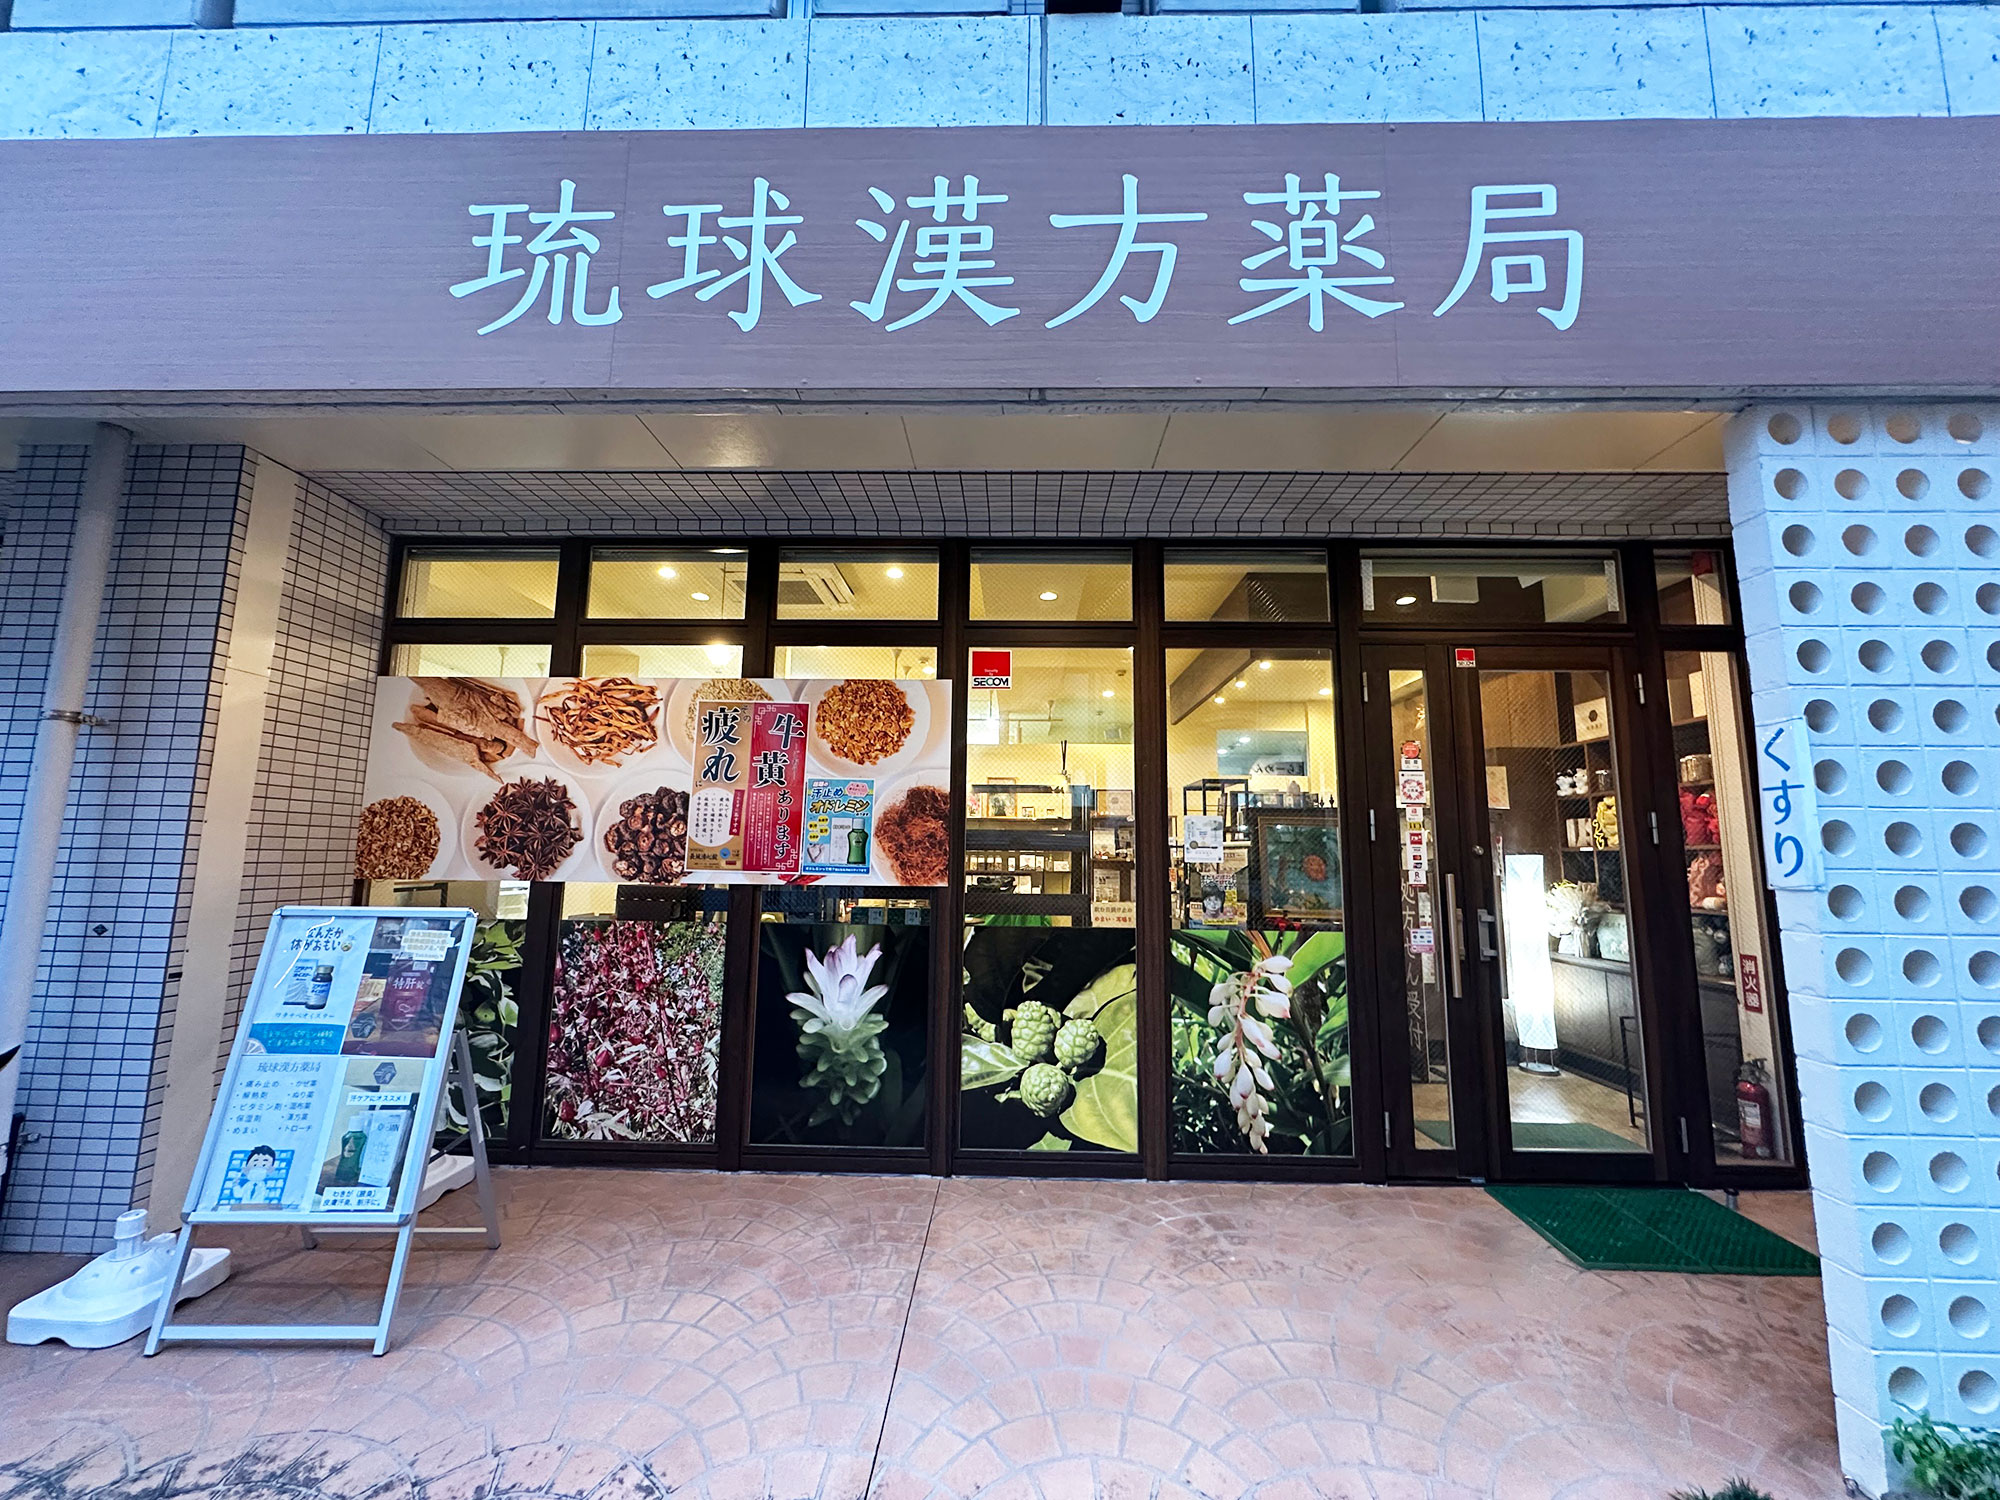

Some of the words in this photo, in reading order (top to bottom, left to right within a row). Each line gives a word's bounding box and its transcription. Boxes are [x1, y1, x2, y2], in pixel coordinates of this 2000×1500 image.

[449, 172, 1587, 335] 琉球漢方薬局
[973, 677, 1009, 687] SECOM
[701, 706, 742, 784] 疲れ
[751, 713, 806, 788] 牛黄
[809, 799, 870, 814] オドレミン
[810, 788, 844, 799] 汗止め
[1762, 727, 1805, 878] くすり
[774, 789, 793, 860] あります
[307, 927, 344, 939] なんだか
[1400, 877, 1424, 1051] 処方せん受付
[1741, 958, 1760, 1008] 消火器
[256, 1061, 322, 1073] 琉球漢方薬局
